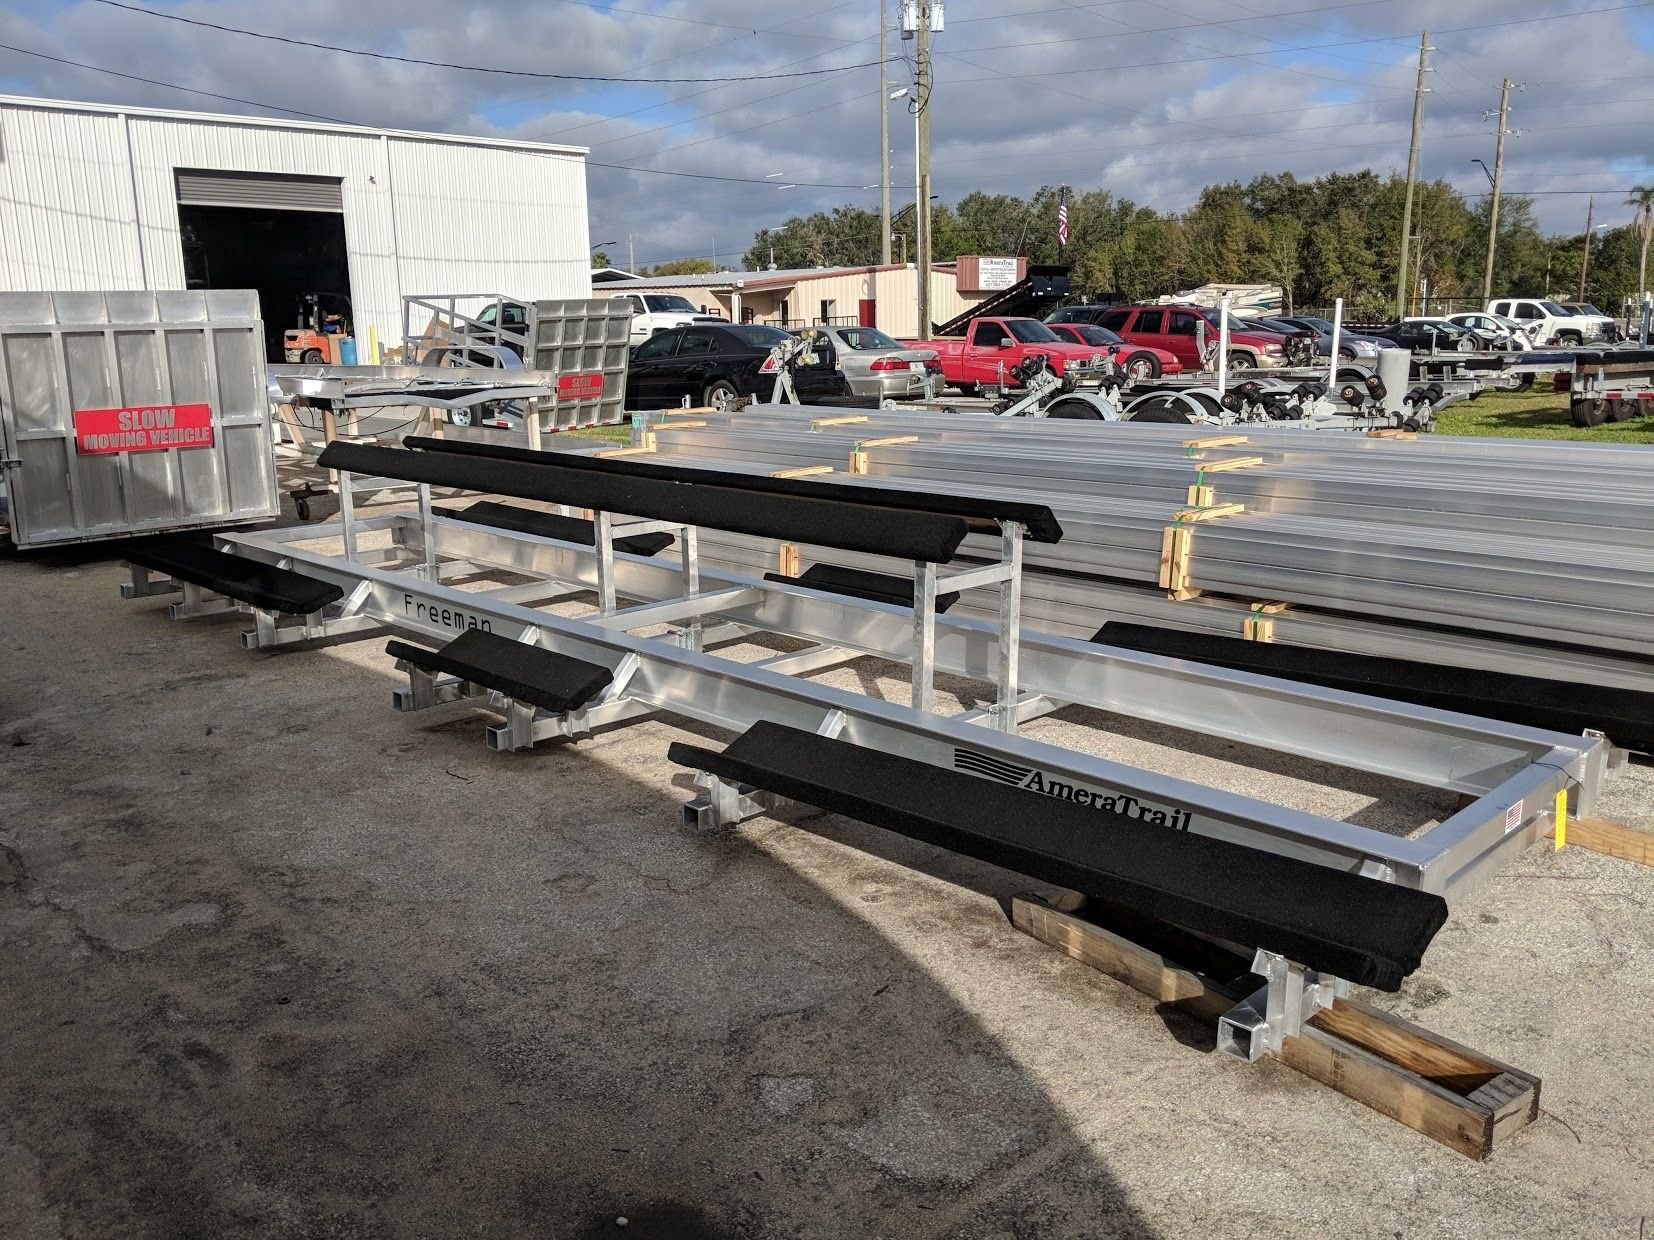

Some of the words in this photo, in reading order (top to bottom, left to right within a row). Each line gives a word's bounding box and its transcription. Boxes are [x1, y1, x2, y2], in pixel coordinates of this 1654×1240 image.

[119, 409, 175, 430] SLOW
[84, 431, 146, 449] MOVING
[150, 427, 209, 444] VEHICLE
[404, 593, 492, 633] Freeman
[1023, 771, 1193, 833] AmeraTrail
